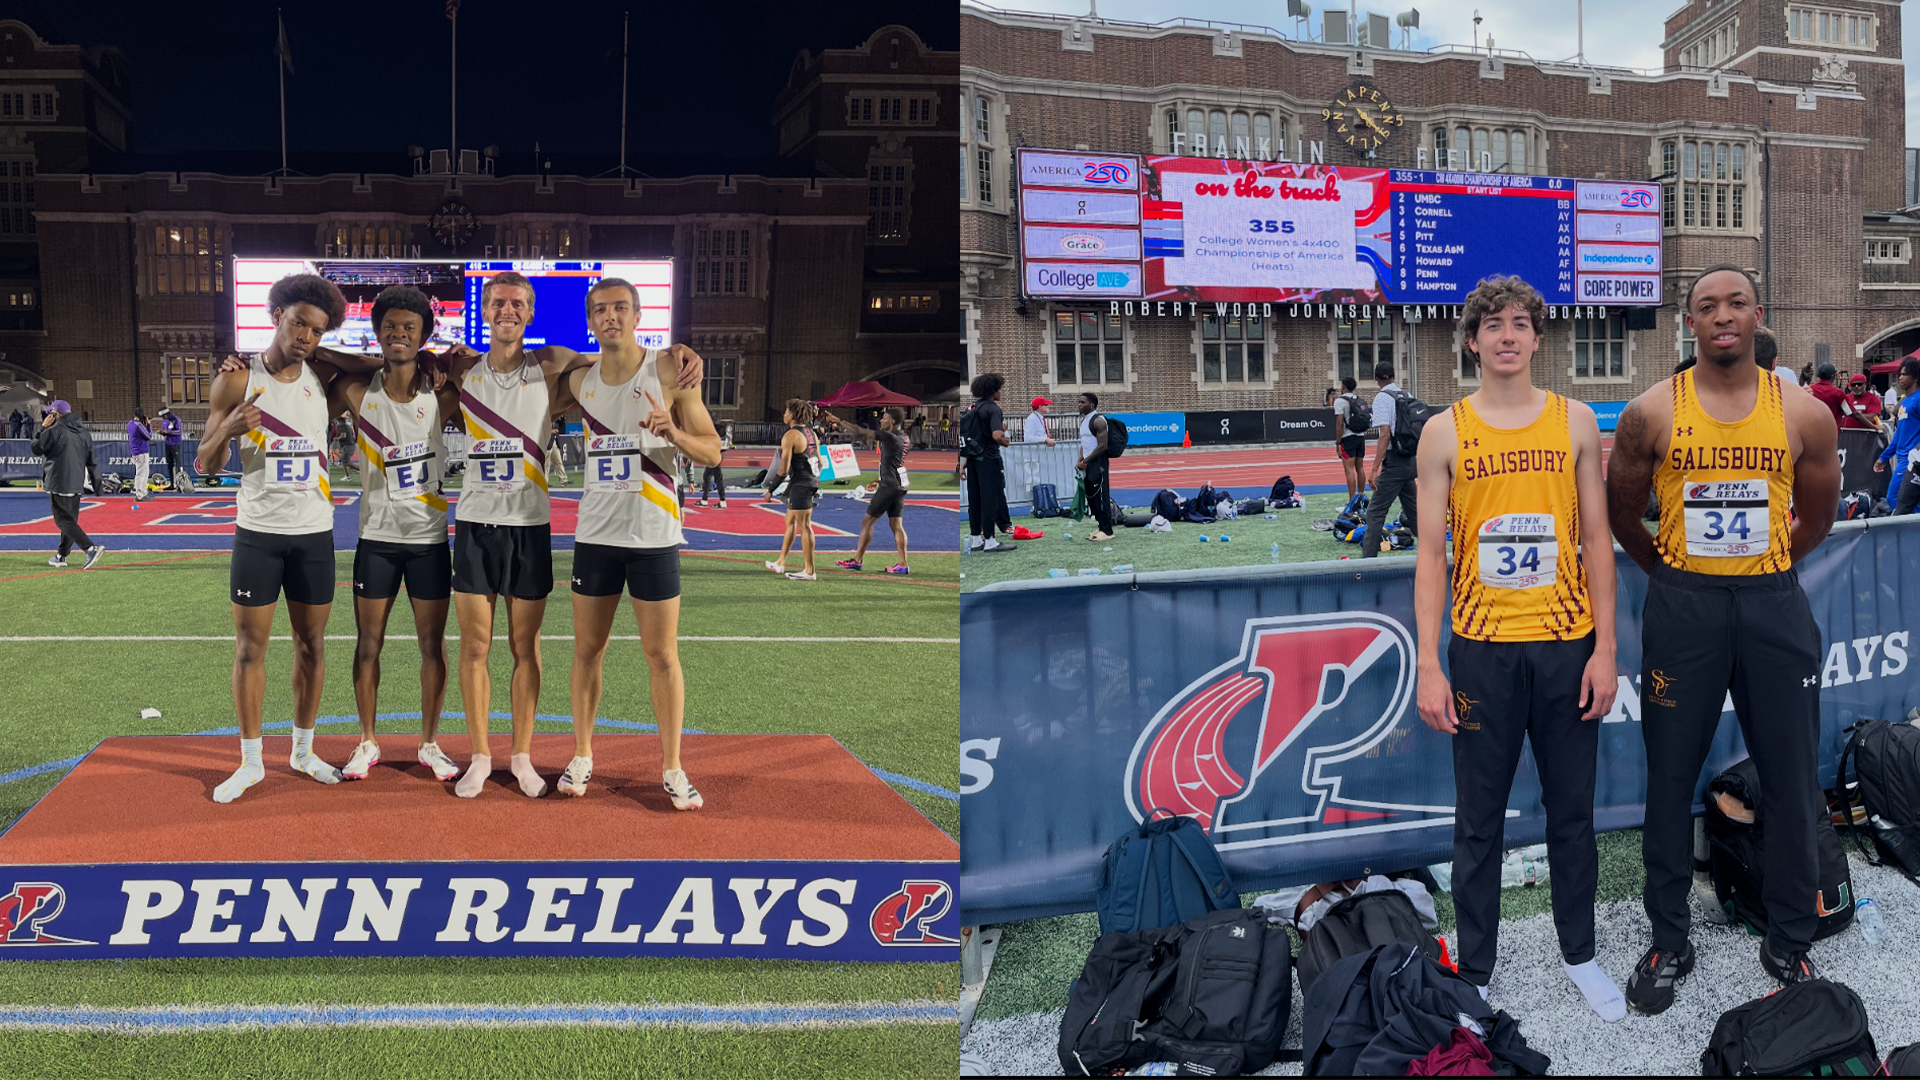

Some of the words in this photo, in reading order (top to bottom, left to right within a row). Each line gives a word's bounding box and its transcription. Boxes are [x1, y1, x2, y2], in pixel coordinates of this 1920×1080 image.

[1173, 132, 1323, 164] FRANKLIN
[1417, 147, 1493, 172] FIELD
[1030, 166, 1082, 176] AMERICA
[1084, 162, 1131, 184] 250
[1195, 182, 1229, 197] on
[1233, 170, 1274, 198] the
[1279, 174, 1341, 202] track
[1464, 174, 1502, 186] CHAMPIONSHIP
[1502, 176, 1510, 187] OF
[1510, 177, 1533, 188] AMERICA
[1549, 179, 1562, 189] 0.0
[1489, 187, 1502, 195] LIST
[1583, 193, 1619, 201] AMERICA
[1621, 189, 1654, 208] 250
[1399, 193, 1405, 203] 2
[1414, 194, 1441, 204] UMBC
[1557, 200, 1570, 209] BB
[1399, 206, 1405, 215] 3
[1558, 212, 1570, 221] AY
[1249, 219, 1295, 234] 355
[1399, 218, 1405, 227] 4
[1558, 224, 1570, 233] AX
[1067, 240, 1099, 249] Grace
[1199, 236, 1243, 246] College
[1246, 238, 1298, 247] Women's
[1302, 239, 1340, 248] 4x400
[1399, 231, 1406, 240] 5
[1558, 236, 1570, 245] AO
[1195, 248, 1280, 259] Championship
[1283, 250, 1295, 259] of
[1297, 251, 1344, 260] America
[1399, 243, 1406, 253] 6
[1558, 248, 1570, 257] AA
[1251, 262, 1294, 271] (Heats)
[1400, 256, 1406, 265] 7
[1558, 259, 1570, 268] AF
[1583, 254, 1643, 264] Independence
[1038, 269, 1095, 290] College
[1100, 274, 1121, 286] AVE
[1400, 268, 1406, 278] 8
[1558, 271, 1571, 280] AH
[1400, 280, 1406, 290] 9
[1558, 283, 1571, 292] AN
[1584, 280, 1612, 297] CORE
[1615, 280, 1654, 297] POWER
[1110, 301, 1197, 316] ROBERT
[1215, 302, 1271, 317] WOOD
[1290, 303, 1386, 319] JOHNSON
[1403, 305, 1461, 320] FAMIL
[636, 335, 663, 347] OWER
[1280, 420, 1308, 429] Dream
[1310, 419, 1326, 428] On.
[606, 441, 634, 449] RELAYS
[1464, 450, 1567, 481] SALISBURY
[1671, 446, 1786, 473] SALISBURY
[277, 459, 310, 482] EJ
[397, 461, 429, 489] EJ
[479, 460, 514, 482] EJ
[598, 457, 630, 482] EJ
[1715, 490, 1759, 498] RELAYS
[1511, 516, 1540, 525] PENN
[1703, 511, 1751, 541] 34
[1509, 525, 1547, 533] RELAYS
[1496, 545, 1541, 576] 34
[1821, 631, 1909, 689] AYS
[109, 878, 423, 946] PENN
[435, 878, 858, 947] RELAYS
